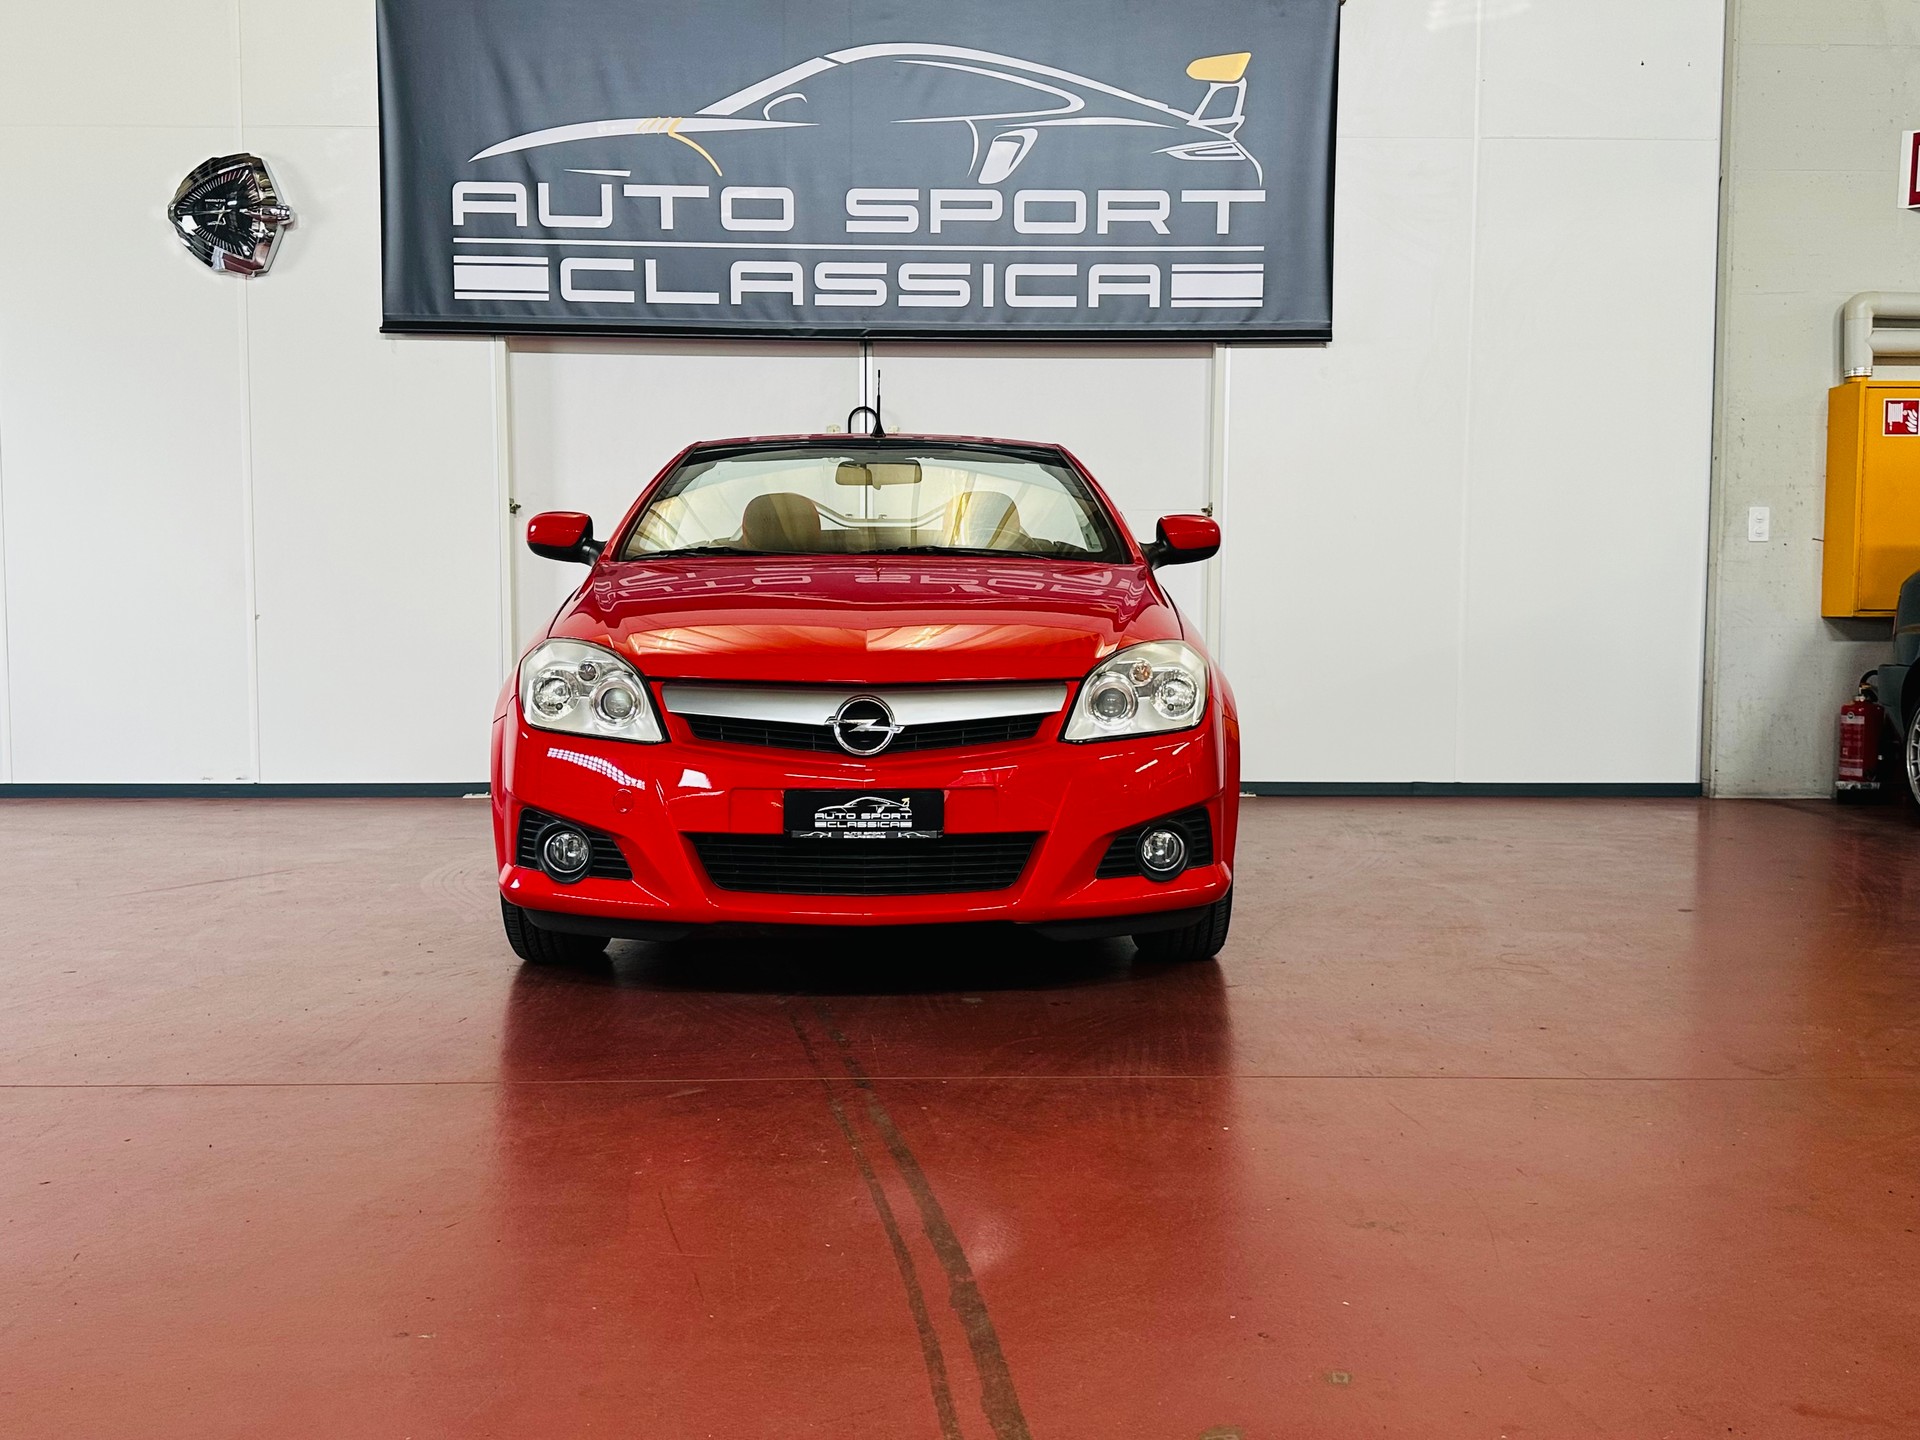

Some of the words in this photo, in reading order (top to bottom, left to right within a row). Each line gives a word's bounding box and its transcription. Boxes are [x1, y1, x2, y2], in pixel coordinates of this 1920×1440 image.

[452, 182, 795, 232] AUTO
[845, 188, 1266, 235] SPORT
[560, 258, 1161, 308] CLASSICA
